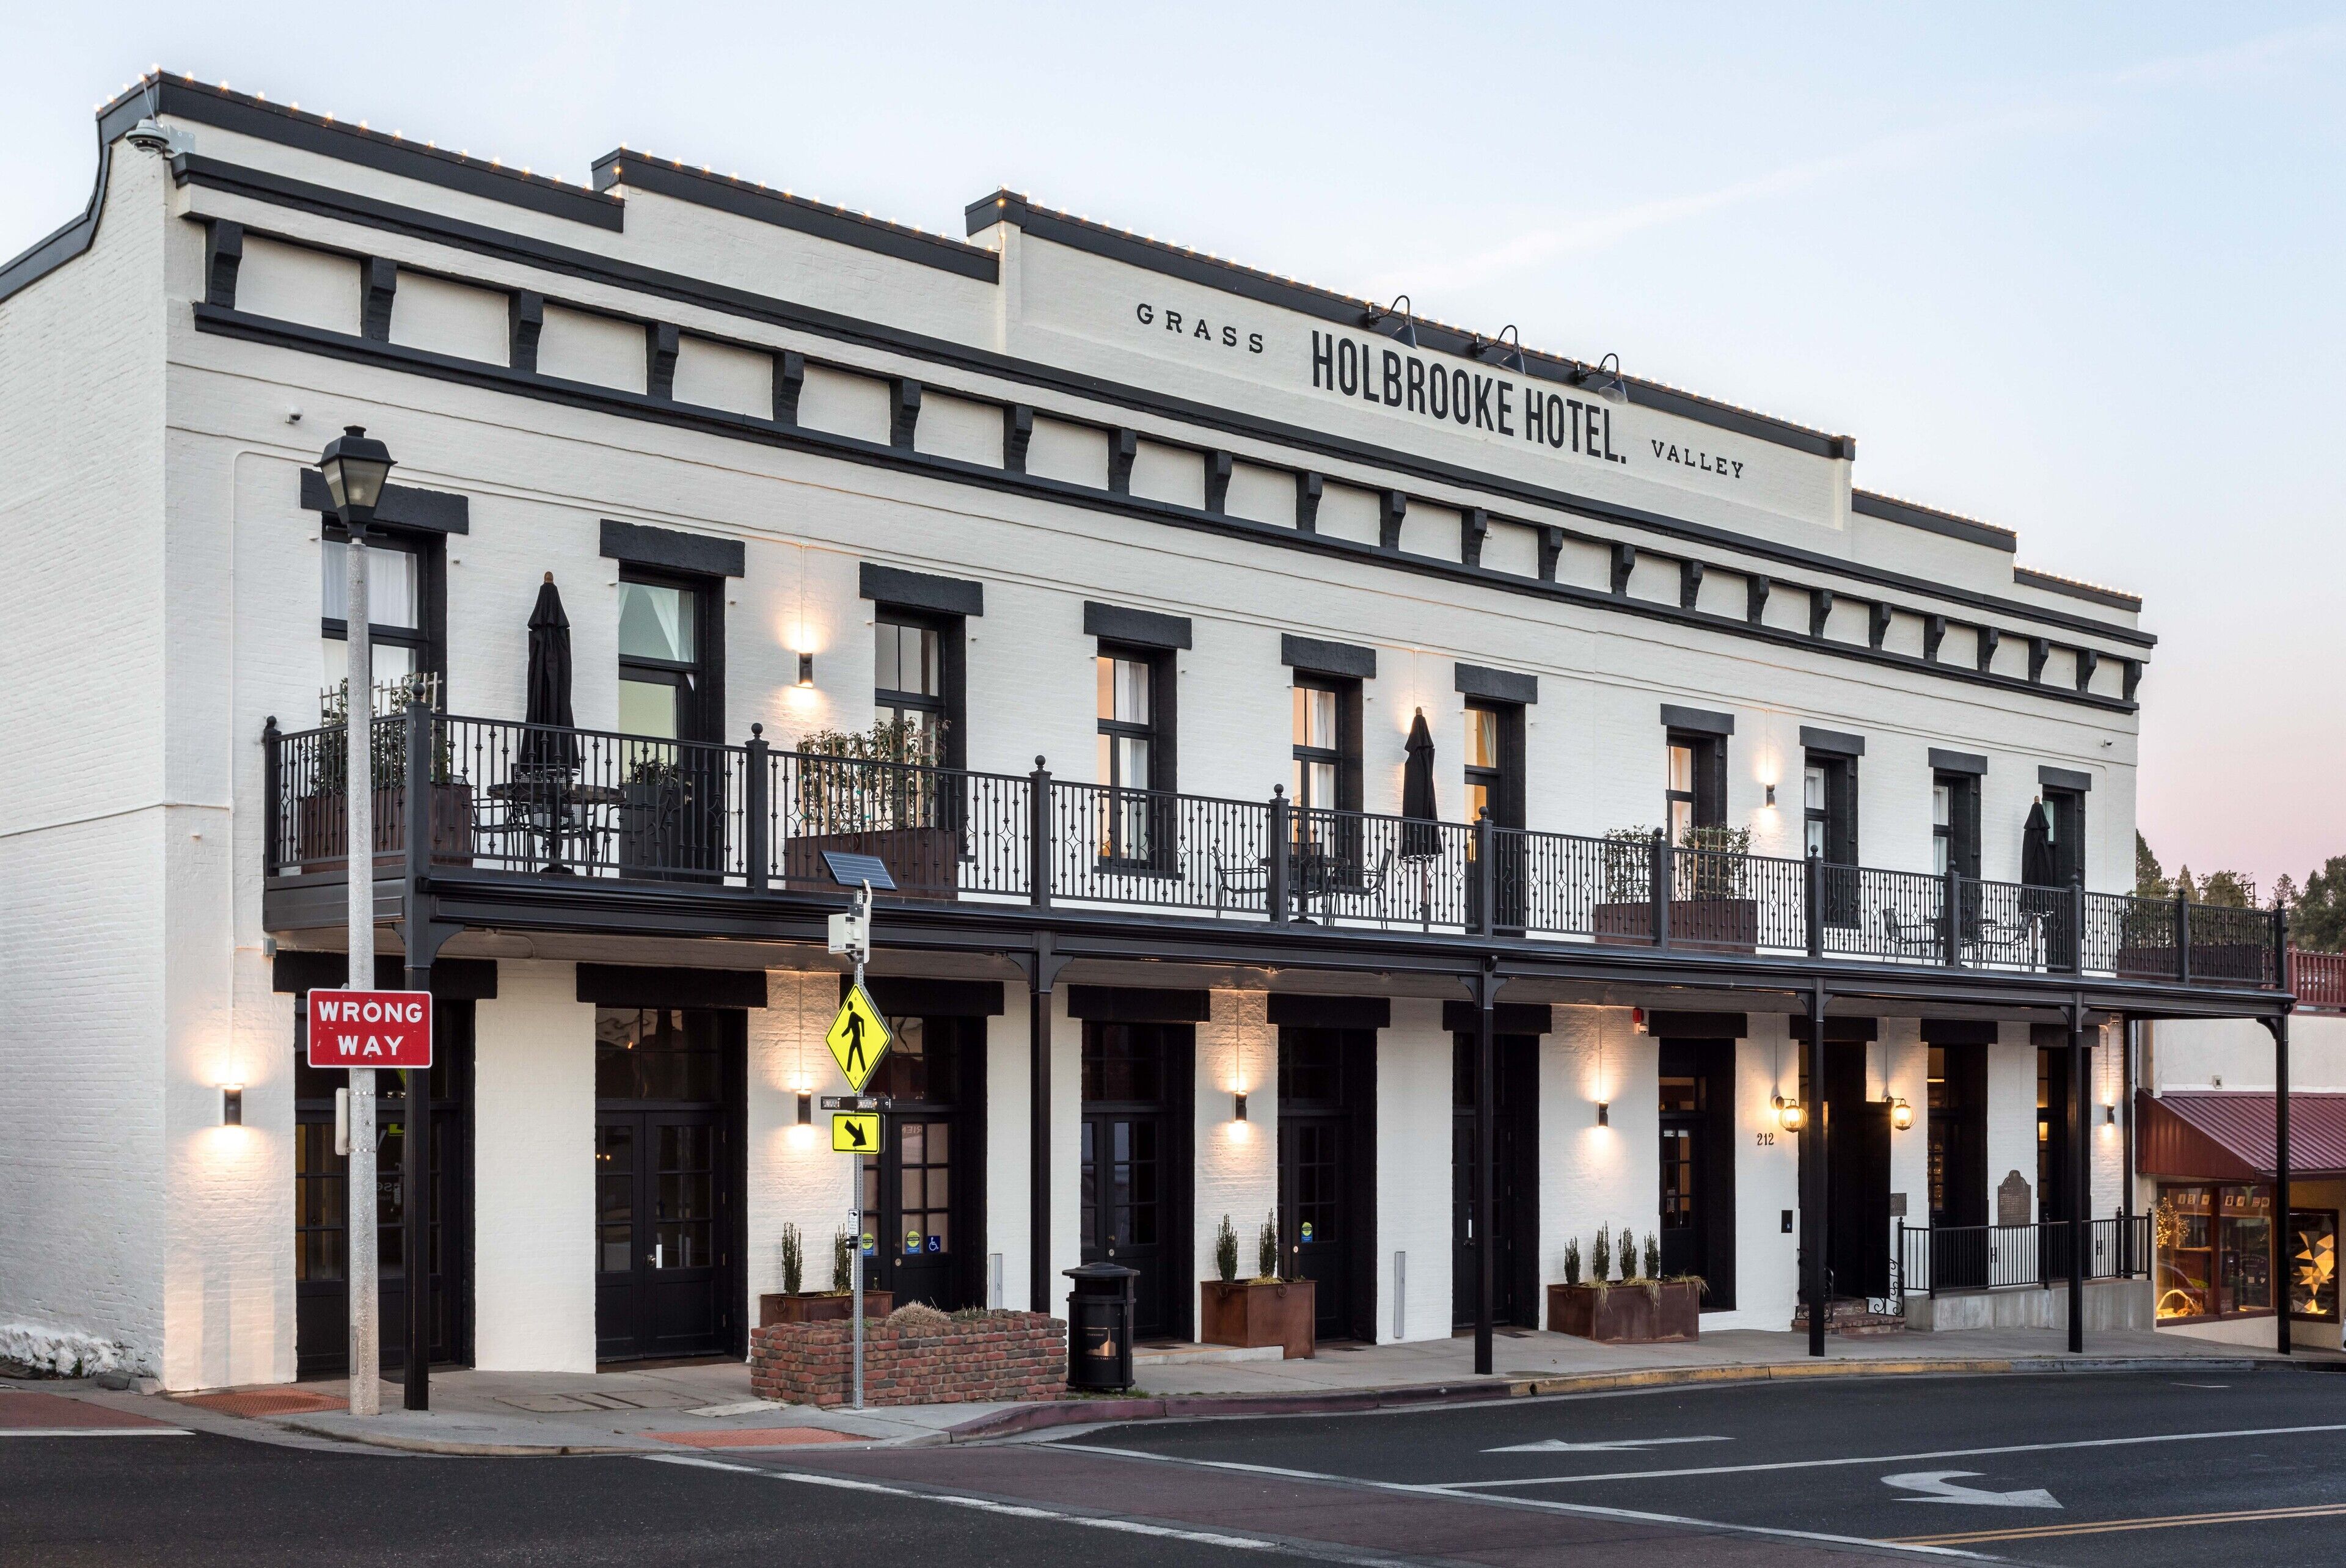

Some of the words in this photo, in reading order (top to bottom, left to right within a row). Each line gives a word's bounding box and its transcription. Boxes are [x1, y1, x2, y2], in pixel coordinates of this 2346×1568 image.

[1136, 303, 1263, 354] GRASS
[1312, 330, 1514, 437] HOLBROOKE
[1526, 387, 1626, 464] HOTEL.
[1651, 439, 1744, 479] VALLEY
[318, 1001, 423, 1023] WRONG
[337, 1035, 404, 1056] WAY
[1757, 1132, 1774, 1146] 212
